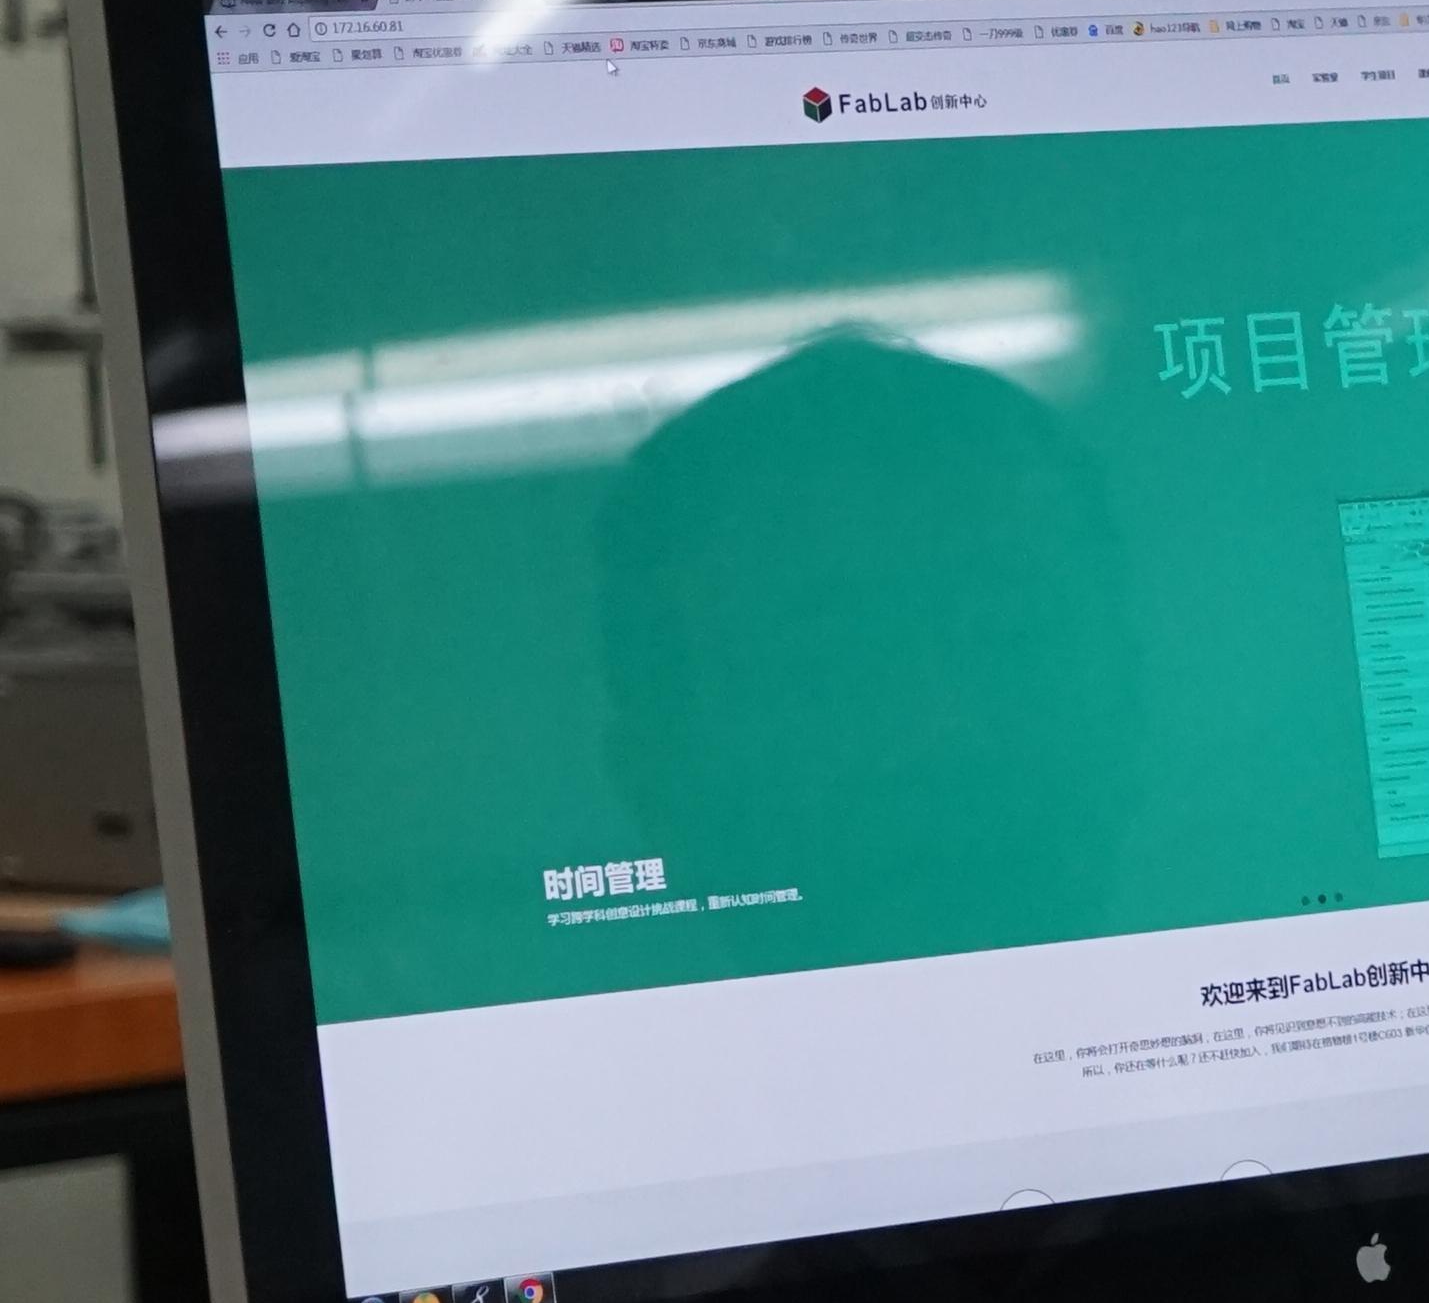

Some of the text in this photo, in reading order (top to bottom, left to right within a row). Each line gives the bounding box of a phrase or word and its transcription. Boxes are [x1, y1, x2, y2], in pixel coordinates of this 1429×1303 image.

[332, 20, 404, 35] 172.16.60.81
[838, 91, 988, 114] FabLab 创新中心
[543, 857, 667, 901] 时间管理
